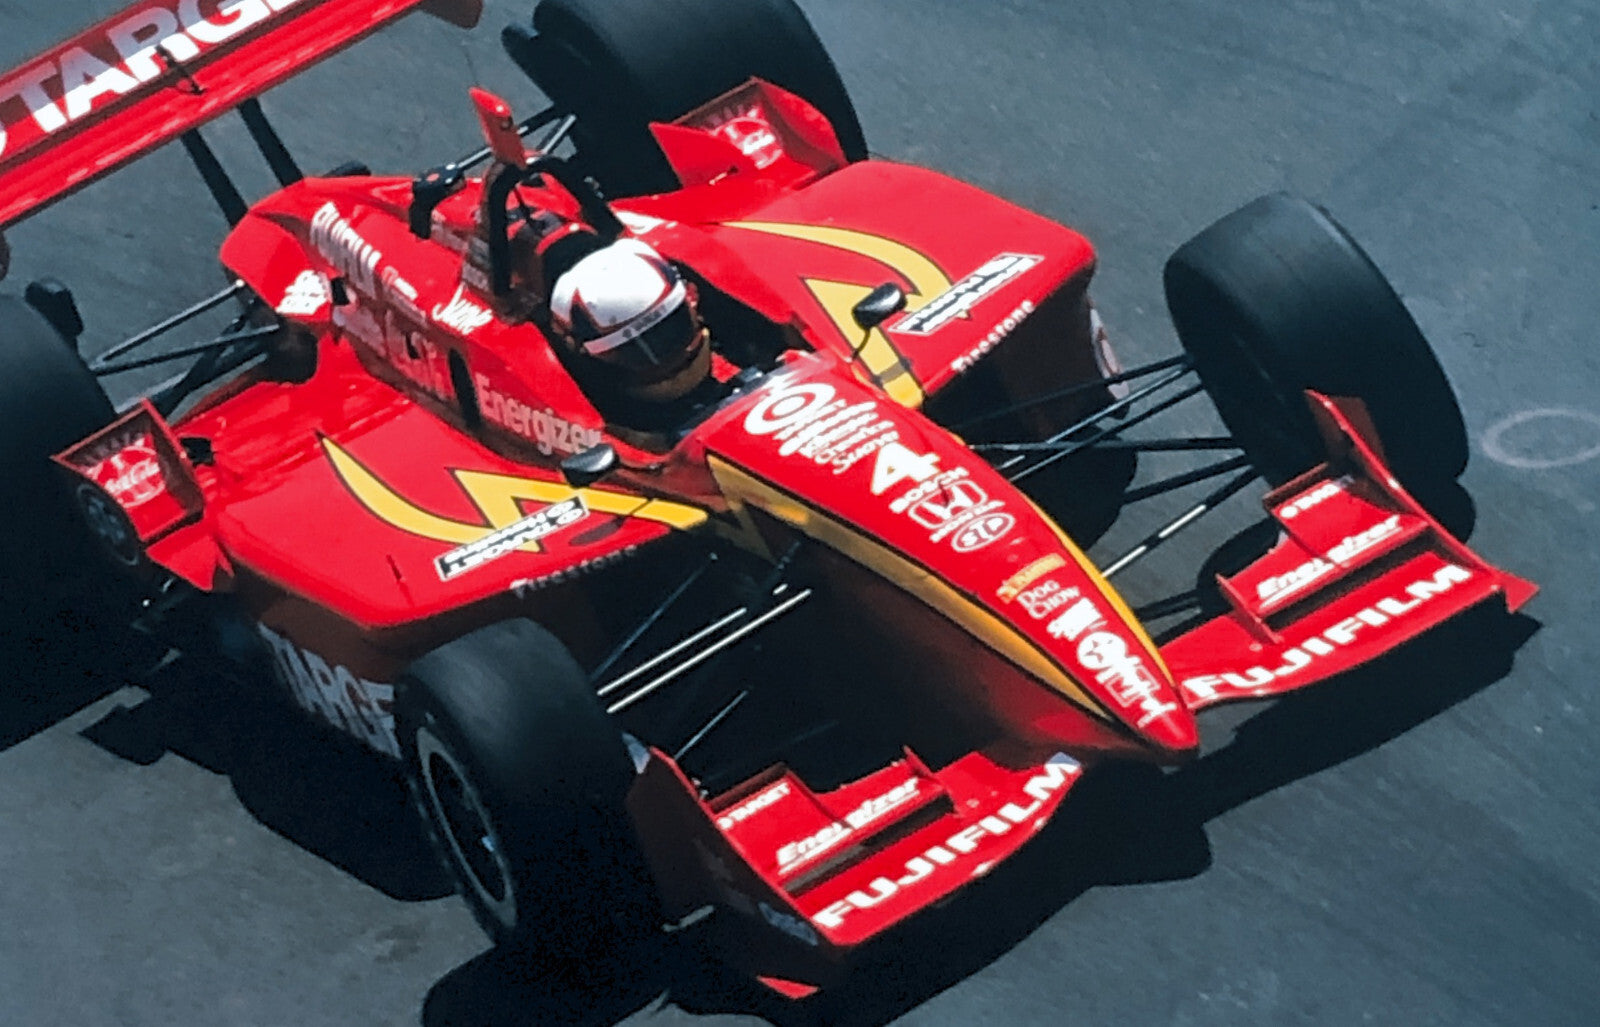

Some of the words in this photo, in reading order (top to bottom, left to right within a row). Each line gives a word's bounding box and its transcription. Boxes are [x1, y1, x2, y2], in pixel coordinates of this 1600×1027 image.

[8, 0, 299, 133] TARG
[950, 300, 1036, 371] Firestone
[475, 373, 602, 455] Energizer
[871, 442, 941, 496] 4
[1017, 579, 1060, 608] DOG
[1182, 563, 1473, 699] FUJIFILM
[812, 752, 1081, 928] FUJIFILM
